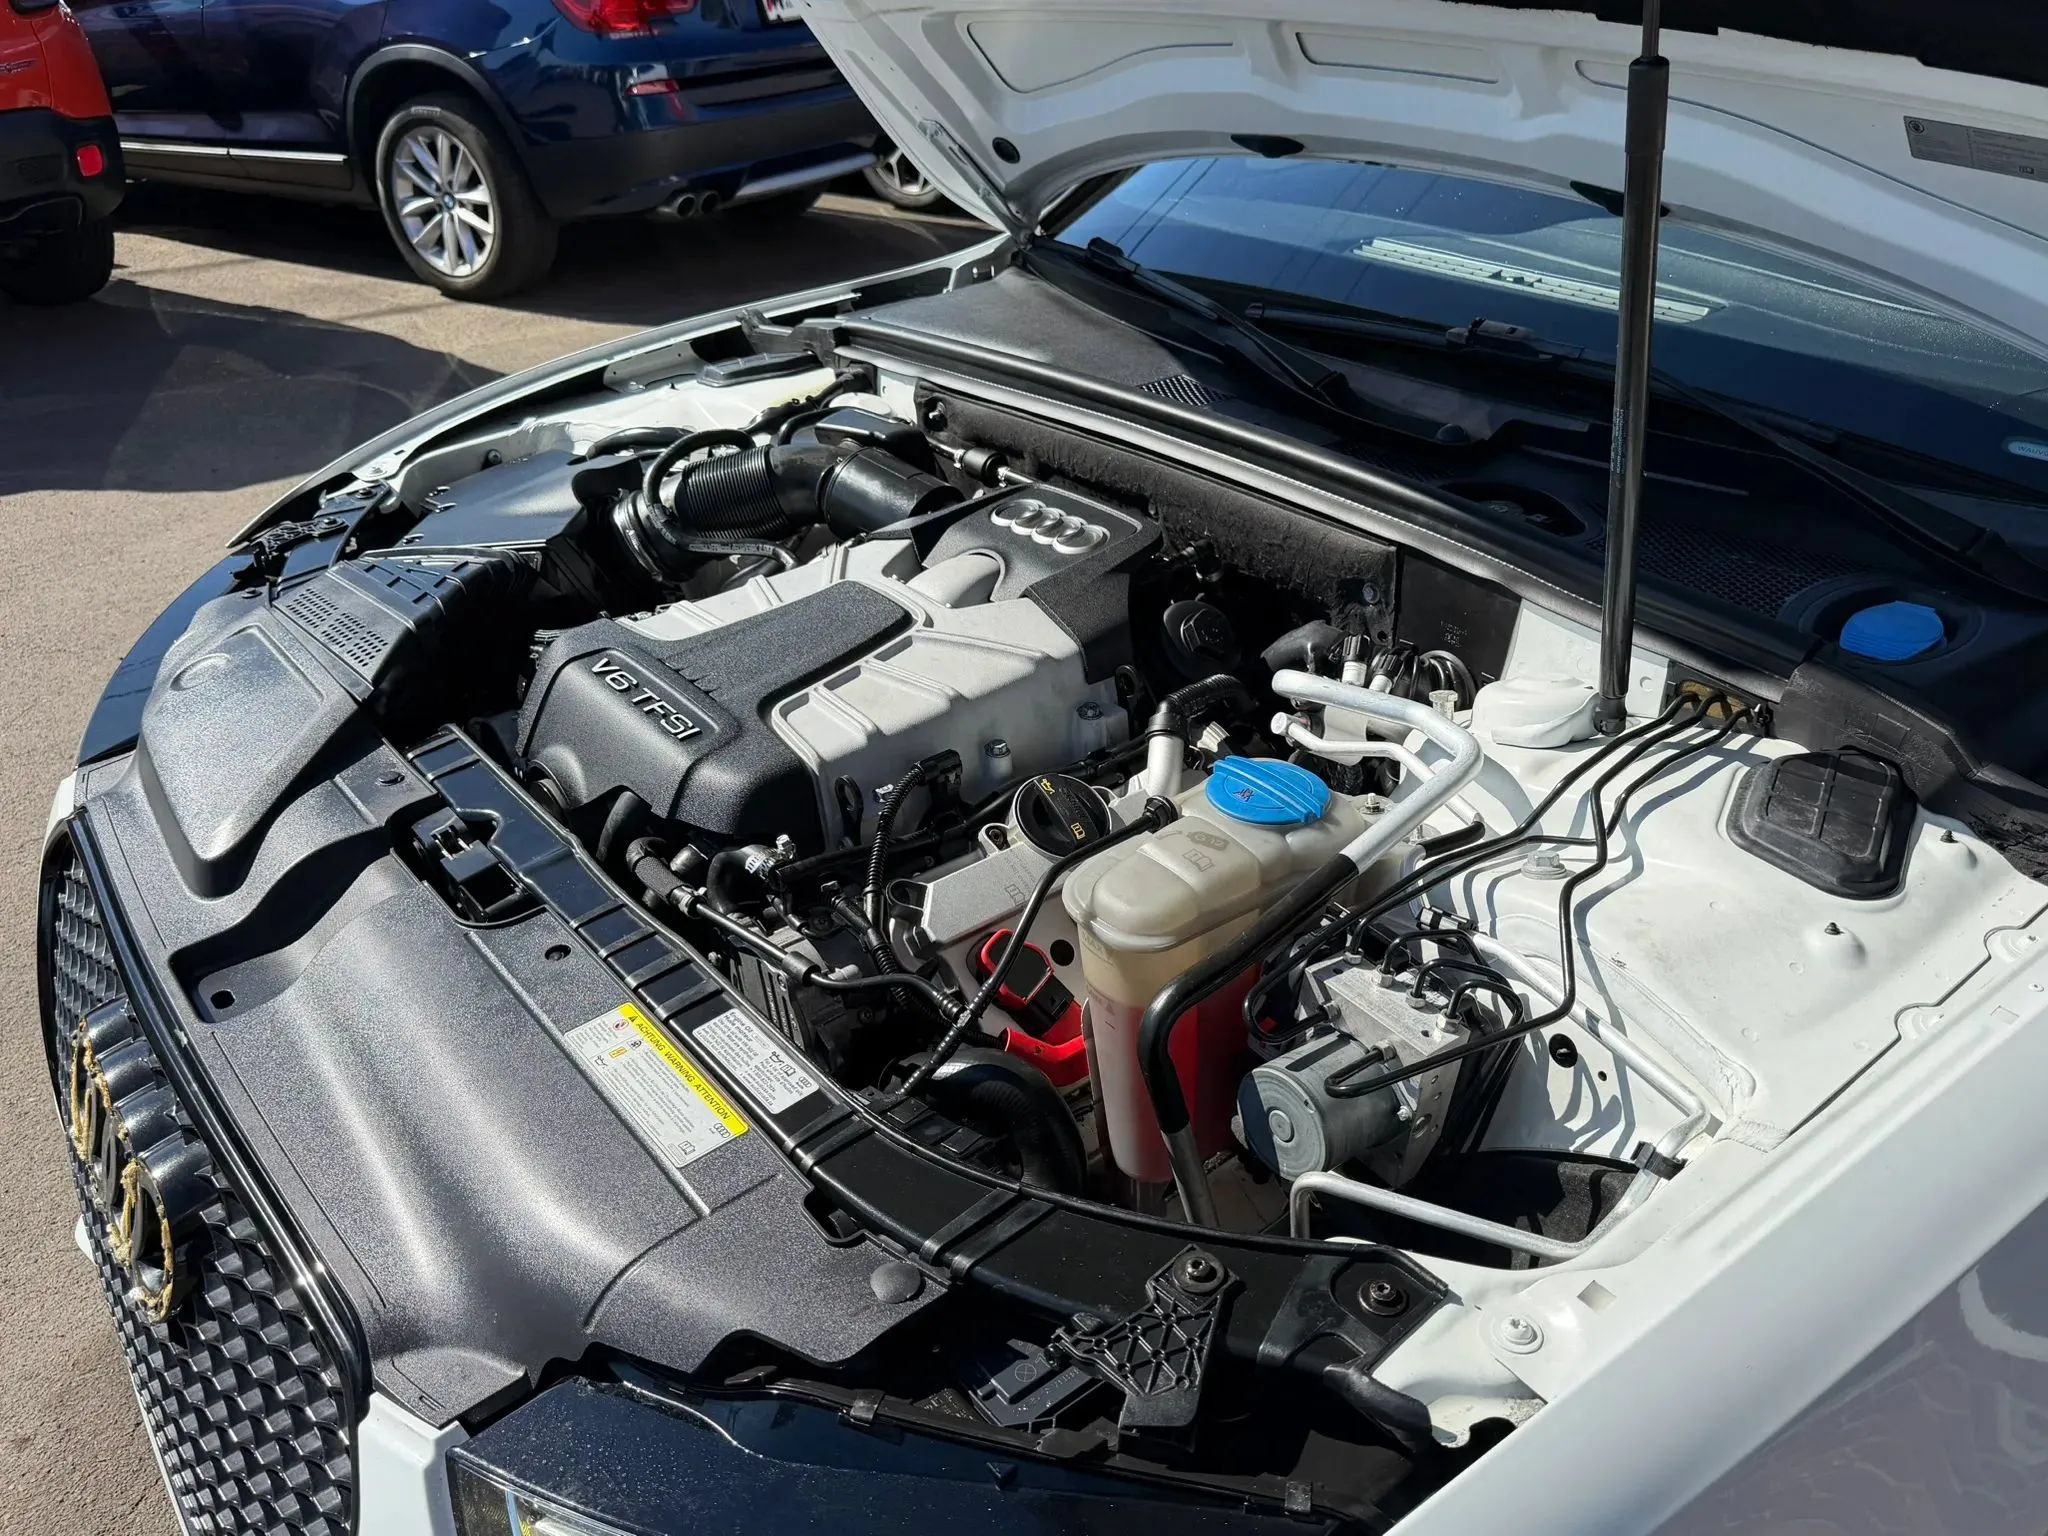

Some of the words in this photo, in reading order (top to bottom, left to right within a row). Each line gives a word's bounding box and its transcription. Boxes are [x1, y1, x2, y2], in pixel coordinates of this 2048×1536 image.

[592, 657, 638, 691] V6
[632, 687, 701, 740] TFSI
[636, 1022, 665, 1051] ACHTUNG
[664, 1051, 696, 1083] WARNING
[694, 1083, 731, 1120] ATTENTION
